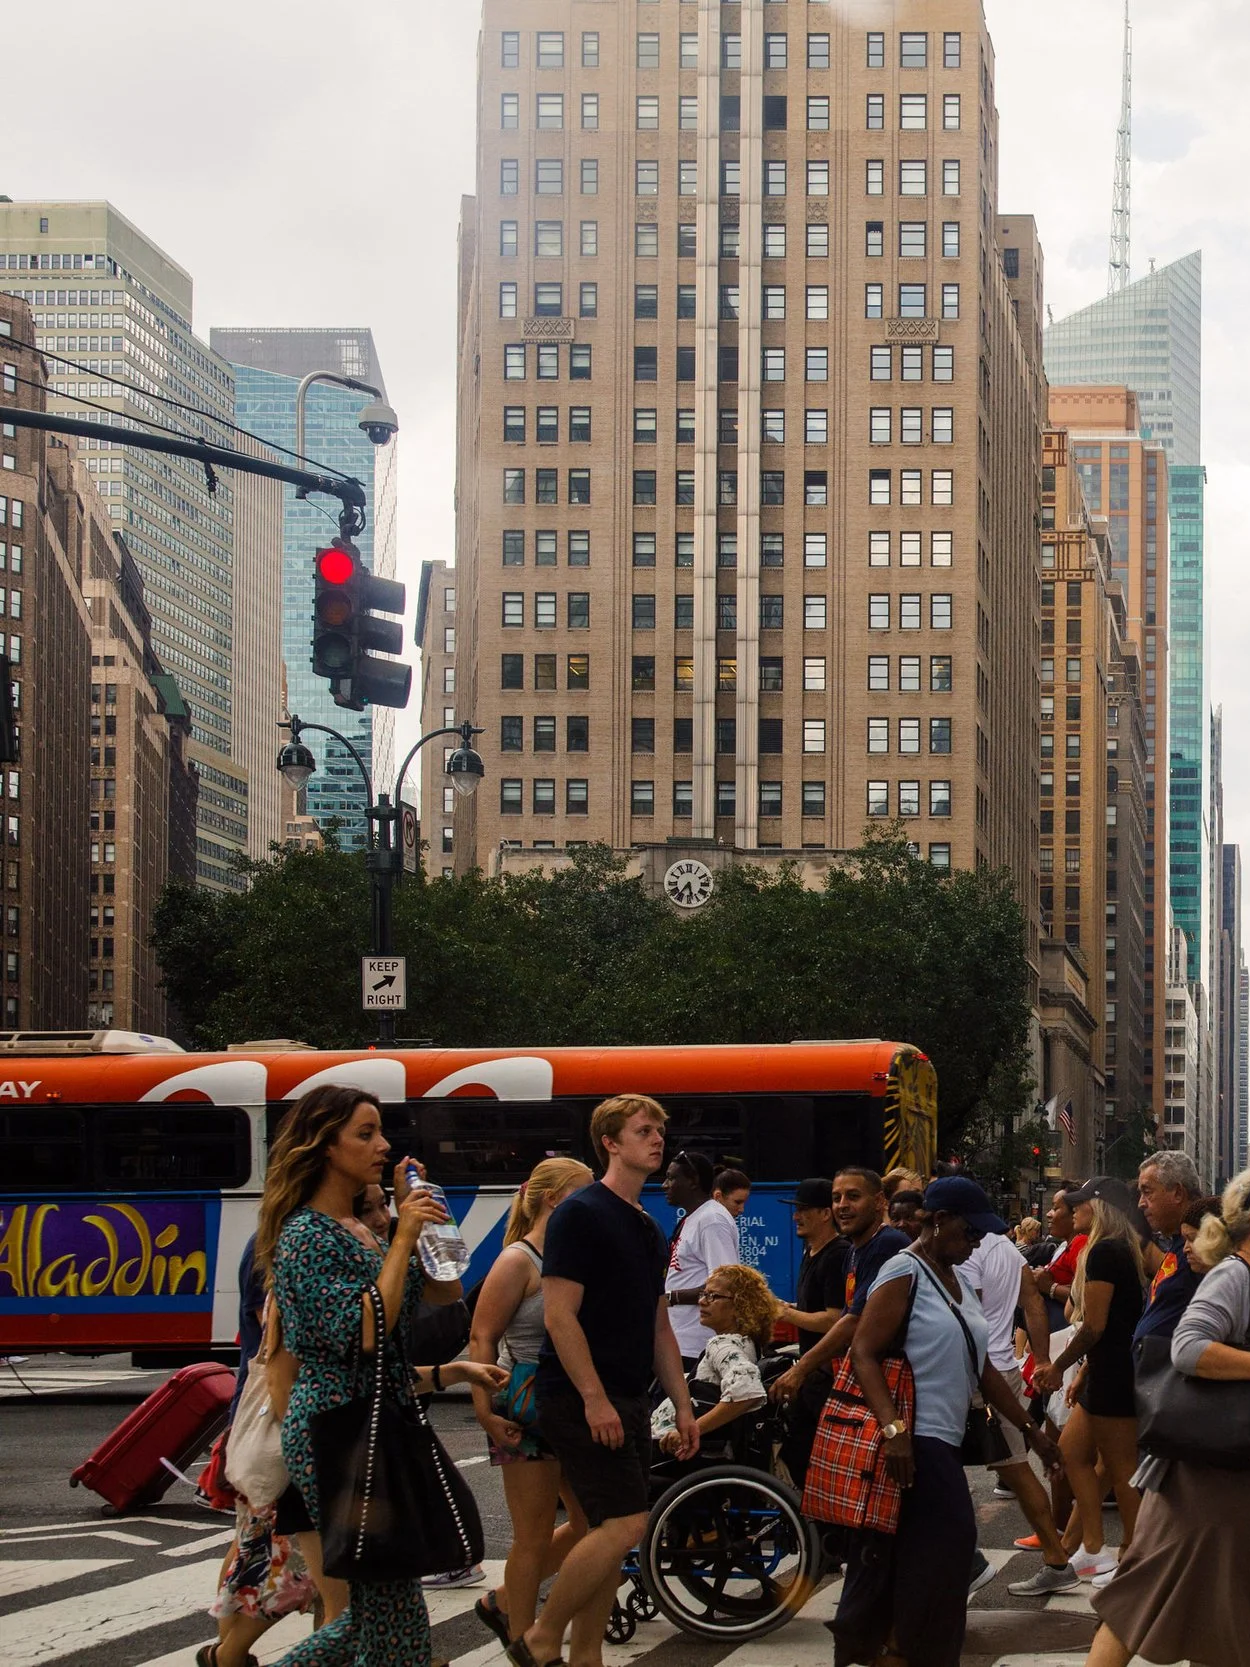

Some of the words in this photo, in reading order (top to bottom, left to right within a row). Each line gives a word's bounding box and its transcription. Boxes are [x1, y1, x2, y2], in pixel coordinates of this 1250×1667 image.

[369, 961, 399, 972] KEEP
[367, 994, 402, 1005] RIGHT
[764, 1236, 779, 1246] NJ
[0, 1203, 208, 1297] Aladdin
